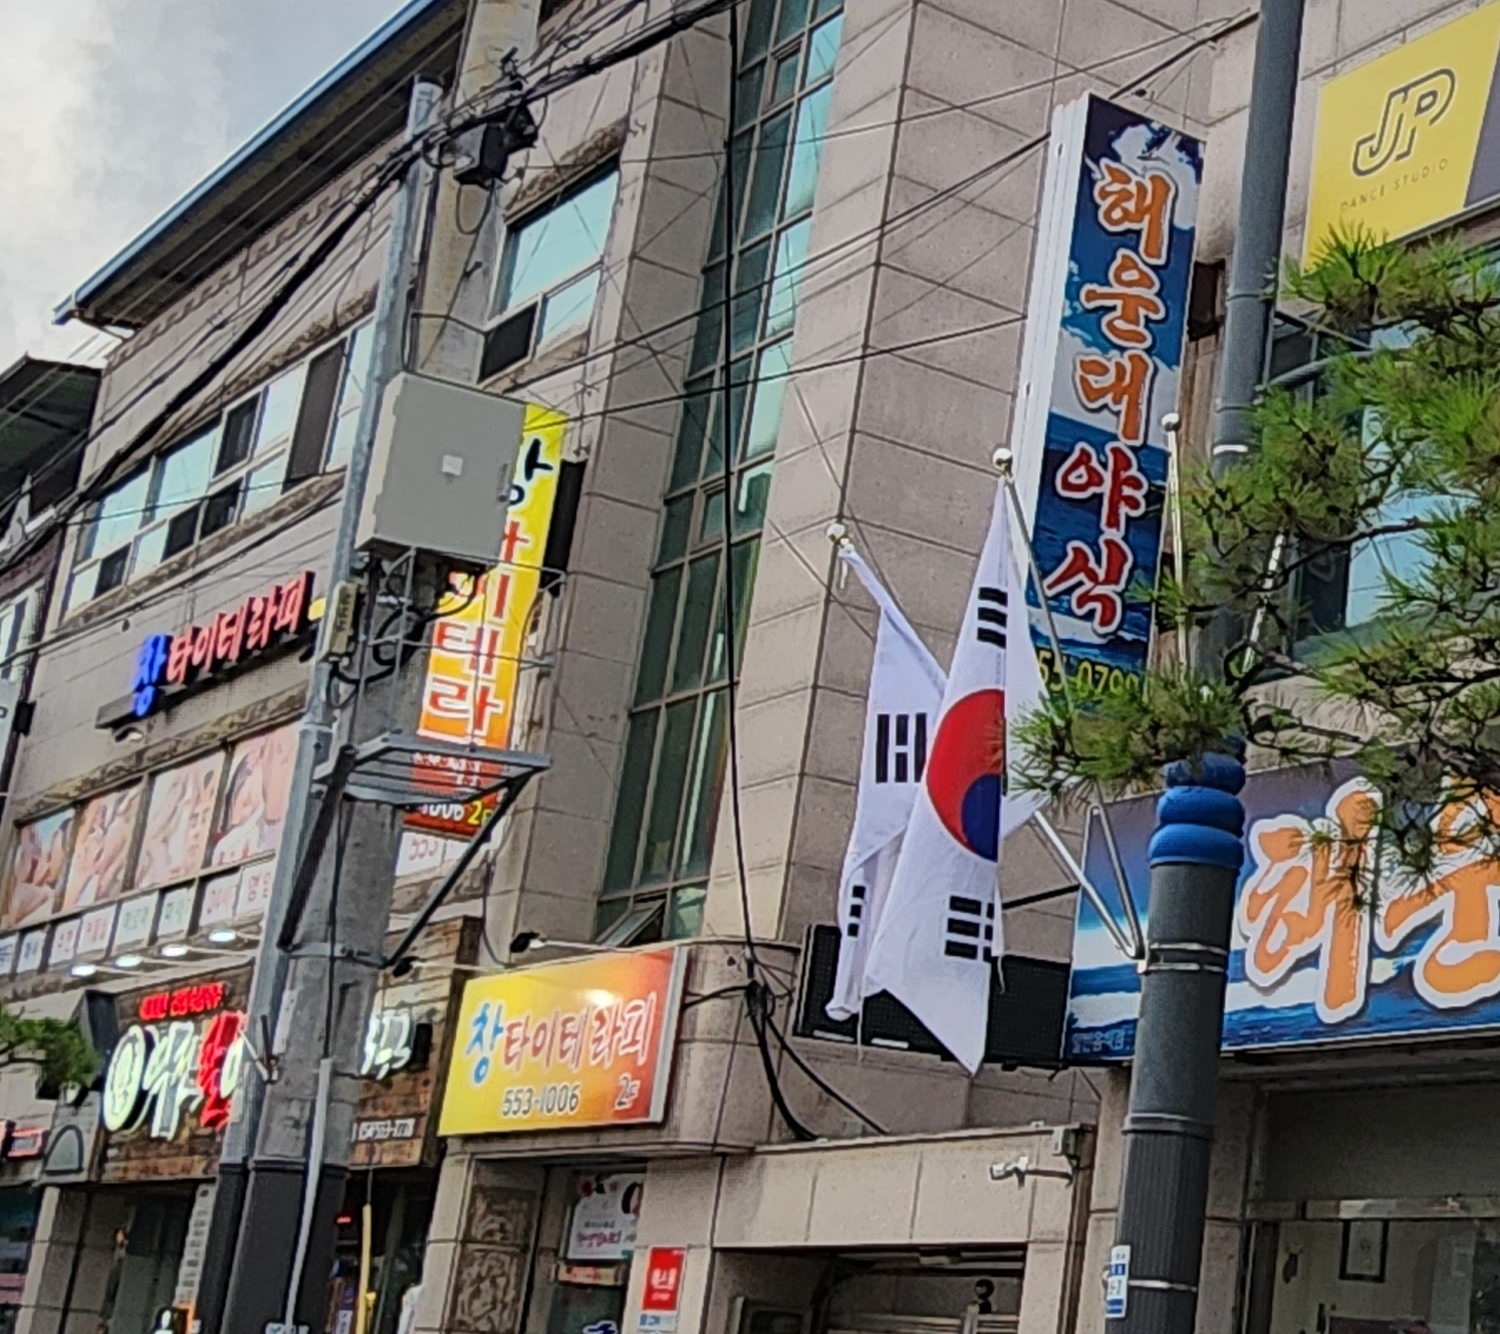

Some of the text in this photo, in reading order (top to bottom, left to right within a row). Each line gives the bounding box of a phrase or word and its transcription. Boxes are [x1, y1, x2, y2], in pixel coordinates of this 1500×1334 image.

[1352, 67, 1456, 177] JP
[1340, 157, 1449, 212] DANCE STUDIO
[502, 1082, 582, 1117] 553-1006
